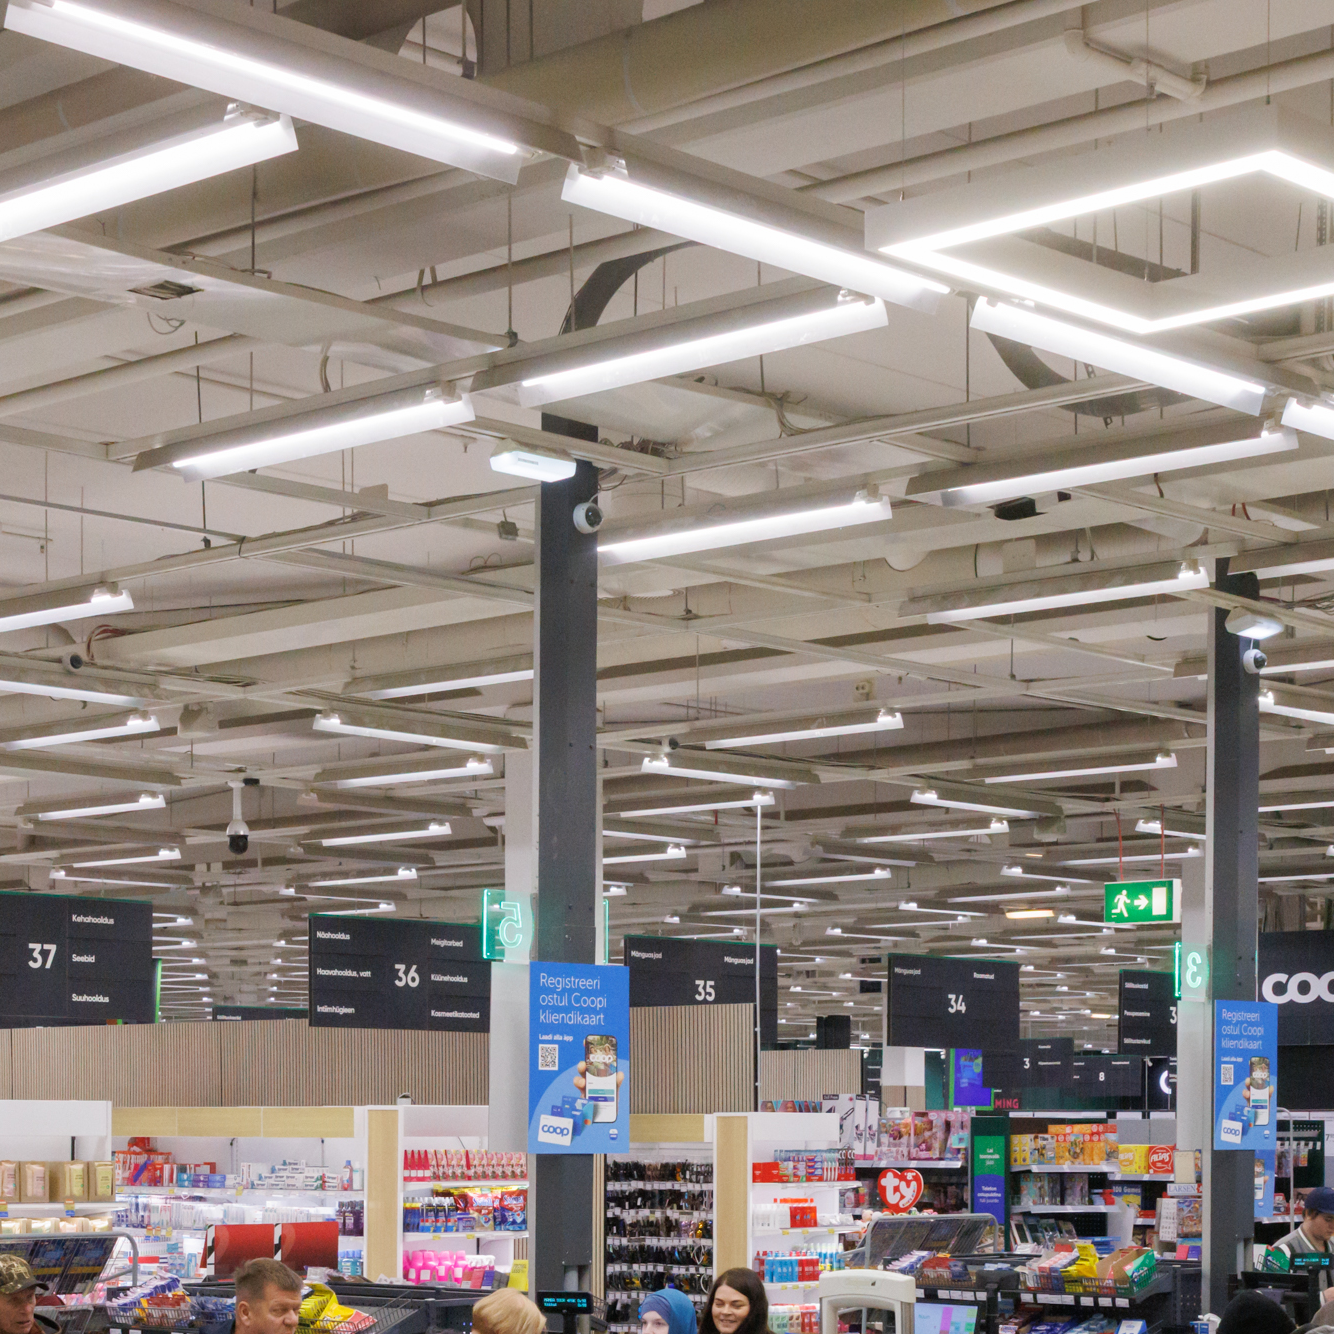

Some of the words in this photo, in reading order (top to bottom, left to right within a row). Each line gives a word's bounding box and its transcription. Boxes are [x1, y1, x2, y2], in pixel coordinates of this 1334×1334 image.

[72, 914, 115, 925] Kehahooldus
[28, 943, 57, 969] 37
[72, 953, 95, 963] Seebid
[394, 963, 420, 988] 36
[540, 973, 601, 992] Registreeri
[72, 993, 110, 1003] Suuhooldus
[694, 979, 716, 1002] 35
[539, 993, 568, 1006] ostul
[571, 992, 607, 1011] Coopi
[947, 994, 966, 1014] 34
[539, 1009, 605, 1026] kliendikaart
[993, 1098, 1019, 1109] MING
[541, 1124, 570, 1137] coop
